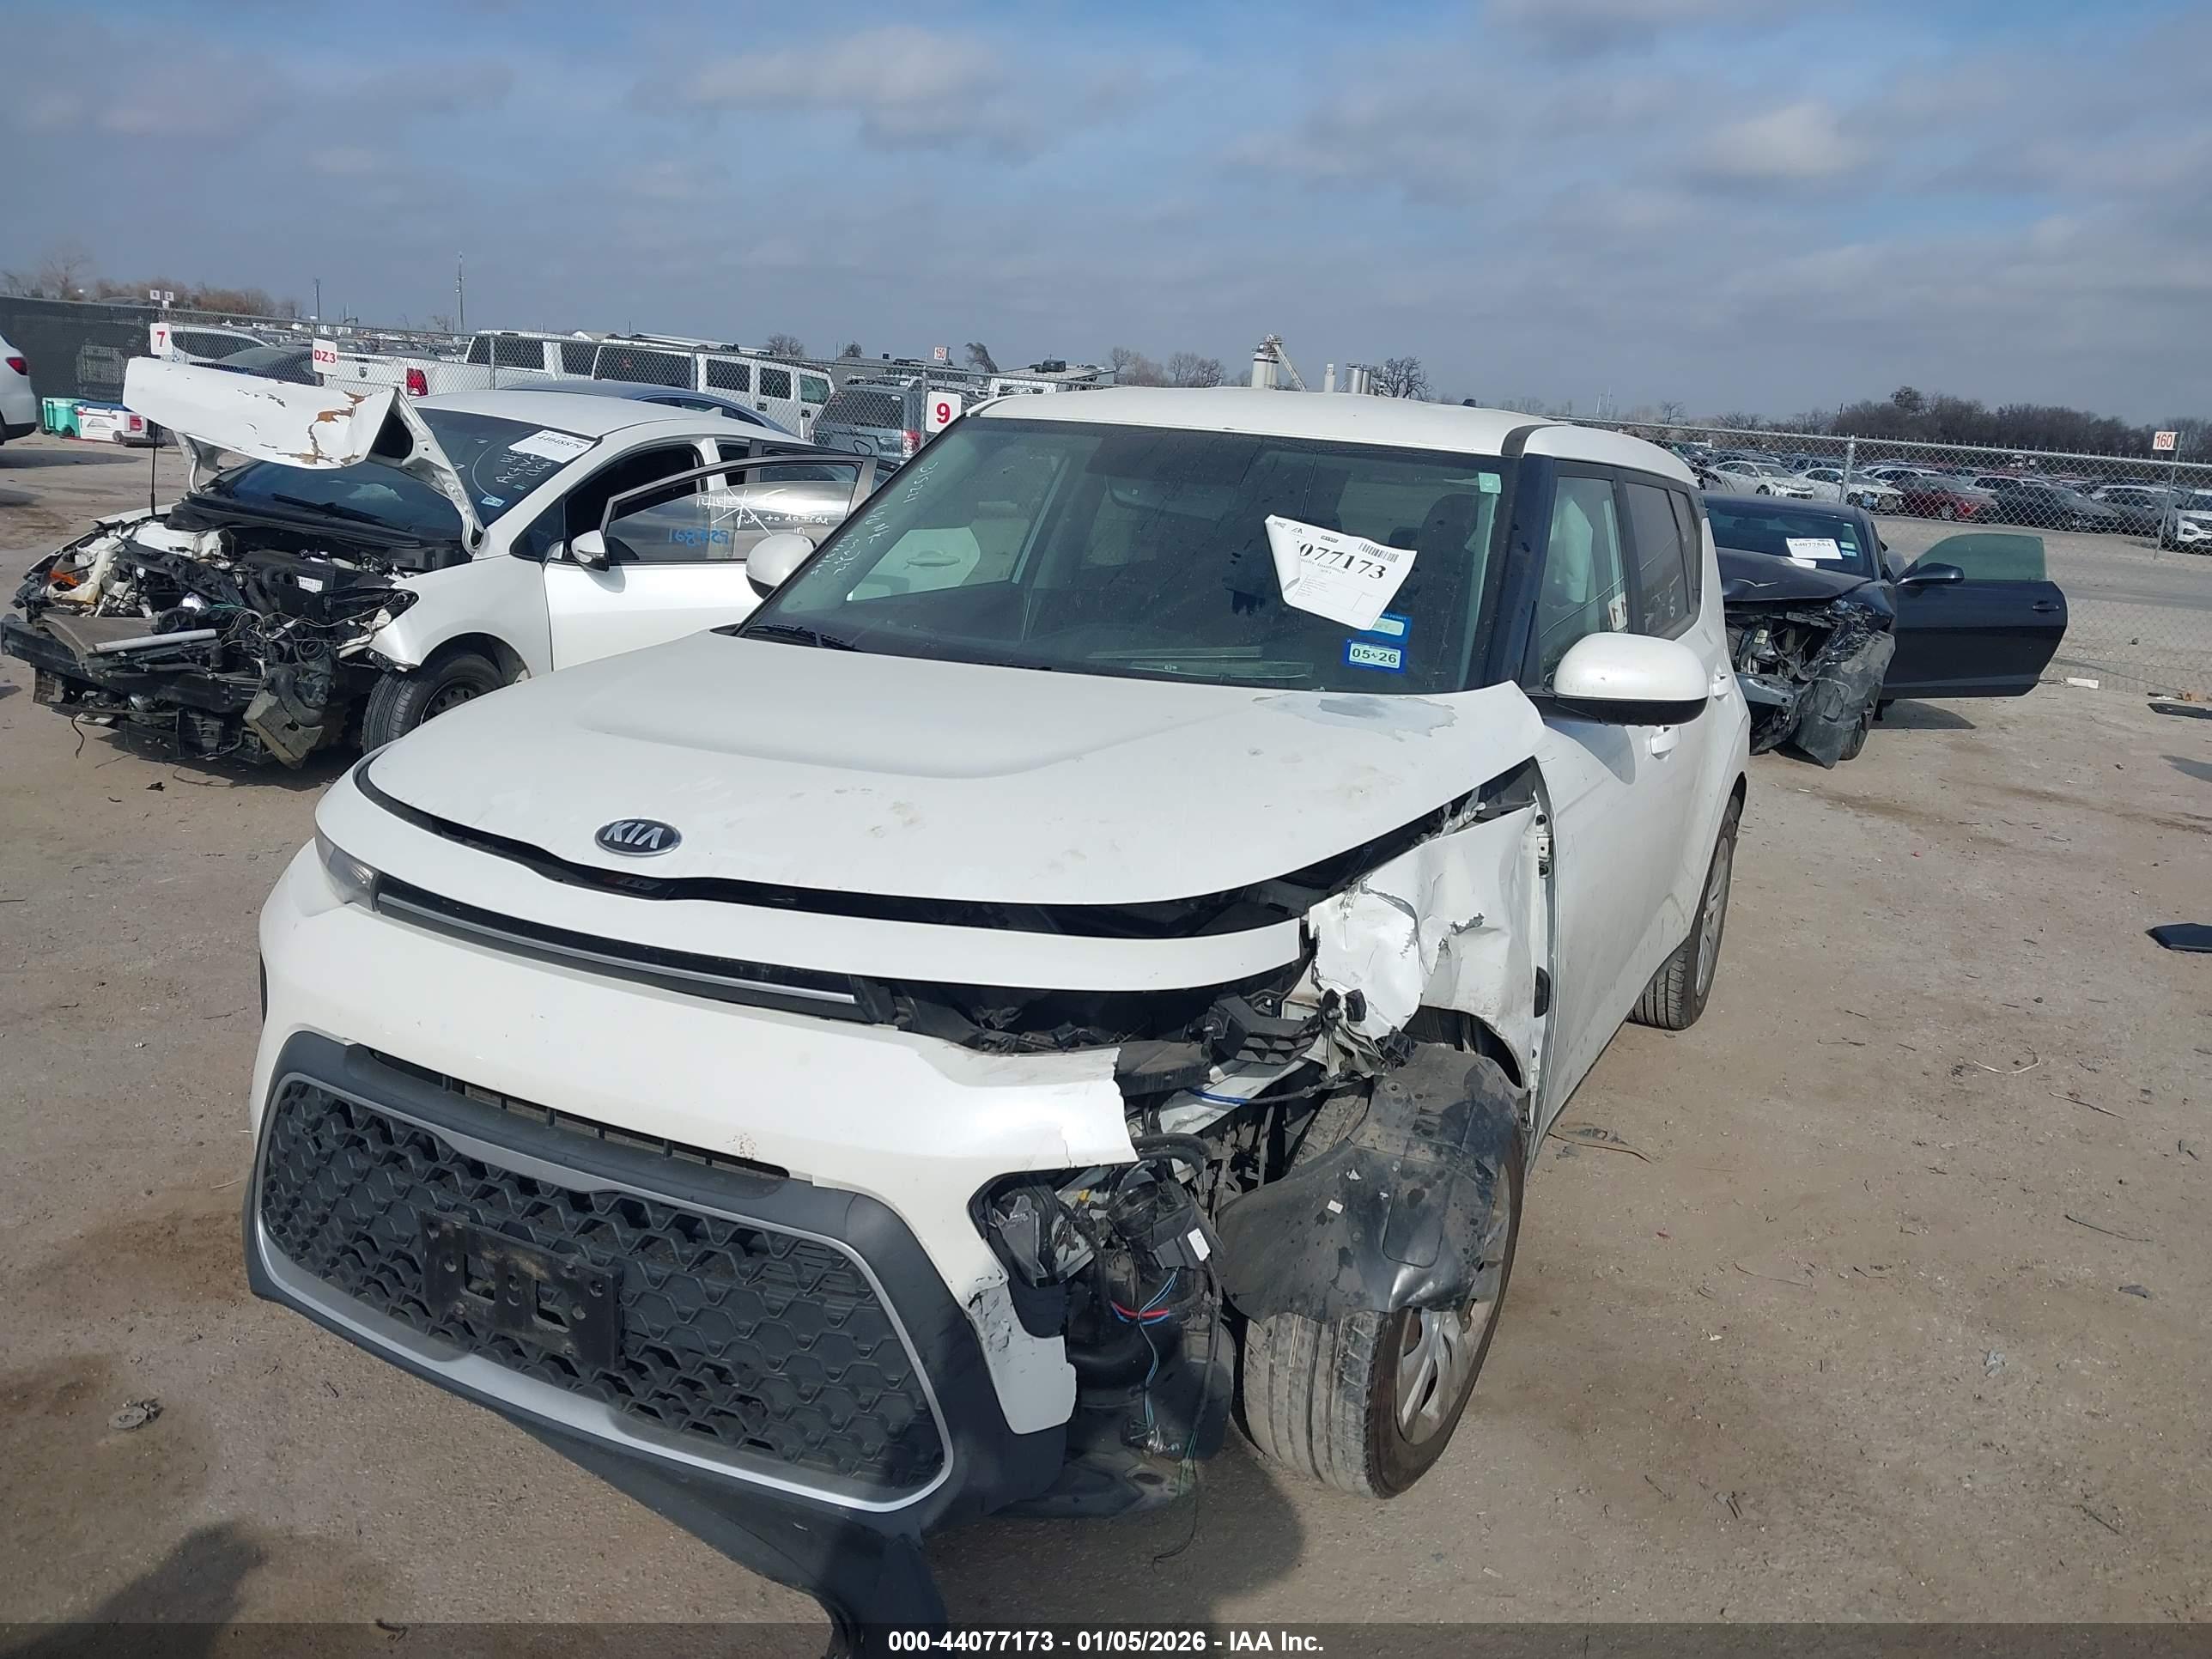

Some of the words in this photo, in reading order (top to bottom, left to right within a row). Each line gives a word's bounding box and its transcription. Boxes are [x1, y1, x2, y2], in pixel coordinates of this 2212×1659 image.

[156, 331, 166, 348] 7
[314, 349, 337, 364] DZ3
[935, 348, 945, 359] 150
[936, 402, 951, 424] 9
[2156, 434, 2173, 447] 160
[1297, 540, 1388, 580] 077173
[603, 821, 665, 849] KIA
